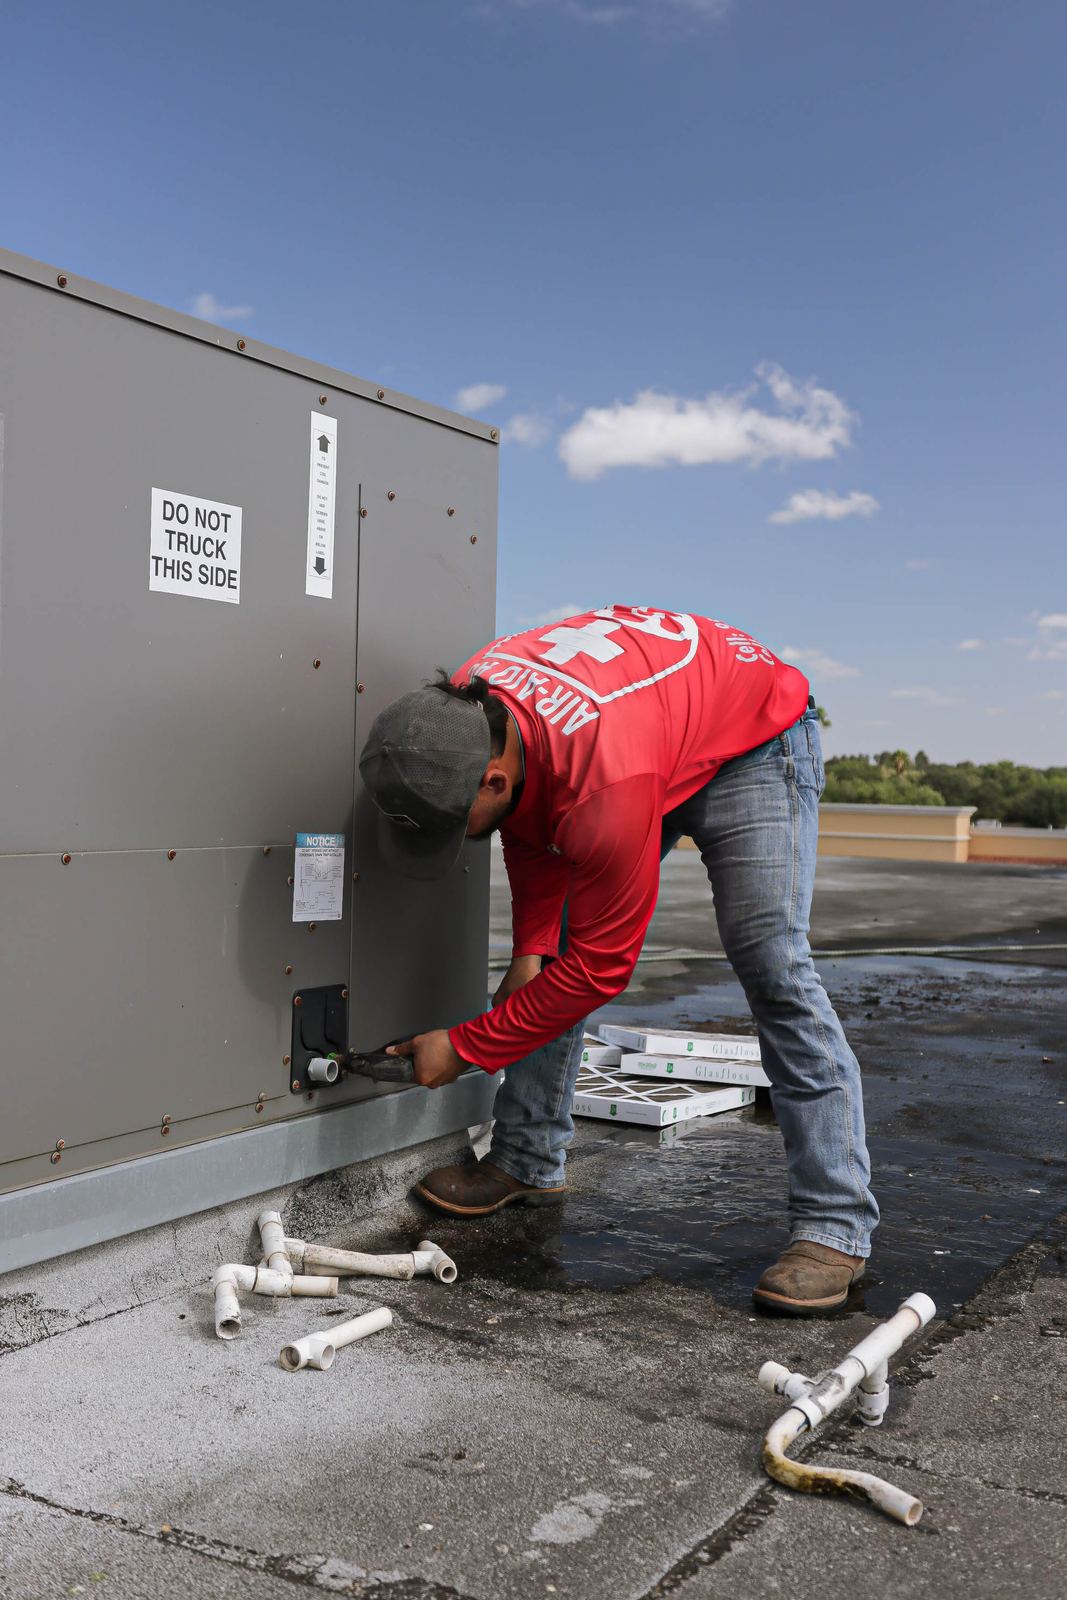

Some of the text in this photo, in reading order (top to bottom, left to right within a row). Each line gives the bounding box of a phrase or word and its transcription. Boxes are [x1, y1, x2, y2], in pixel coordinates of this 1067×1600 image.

[162, 499, 231, 533] DO NOT
[164, 529, 227, 561] TRUCK
[151, 555, 238, 590] THIS SIDE
[488, 665, 600, 736] AIR-AID
[306, 836, 336, 847] NOTICE
[712, 1043, 760, 1058] Glasfloss
[695, 1066, 750, 1082] Glasfloss
